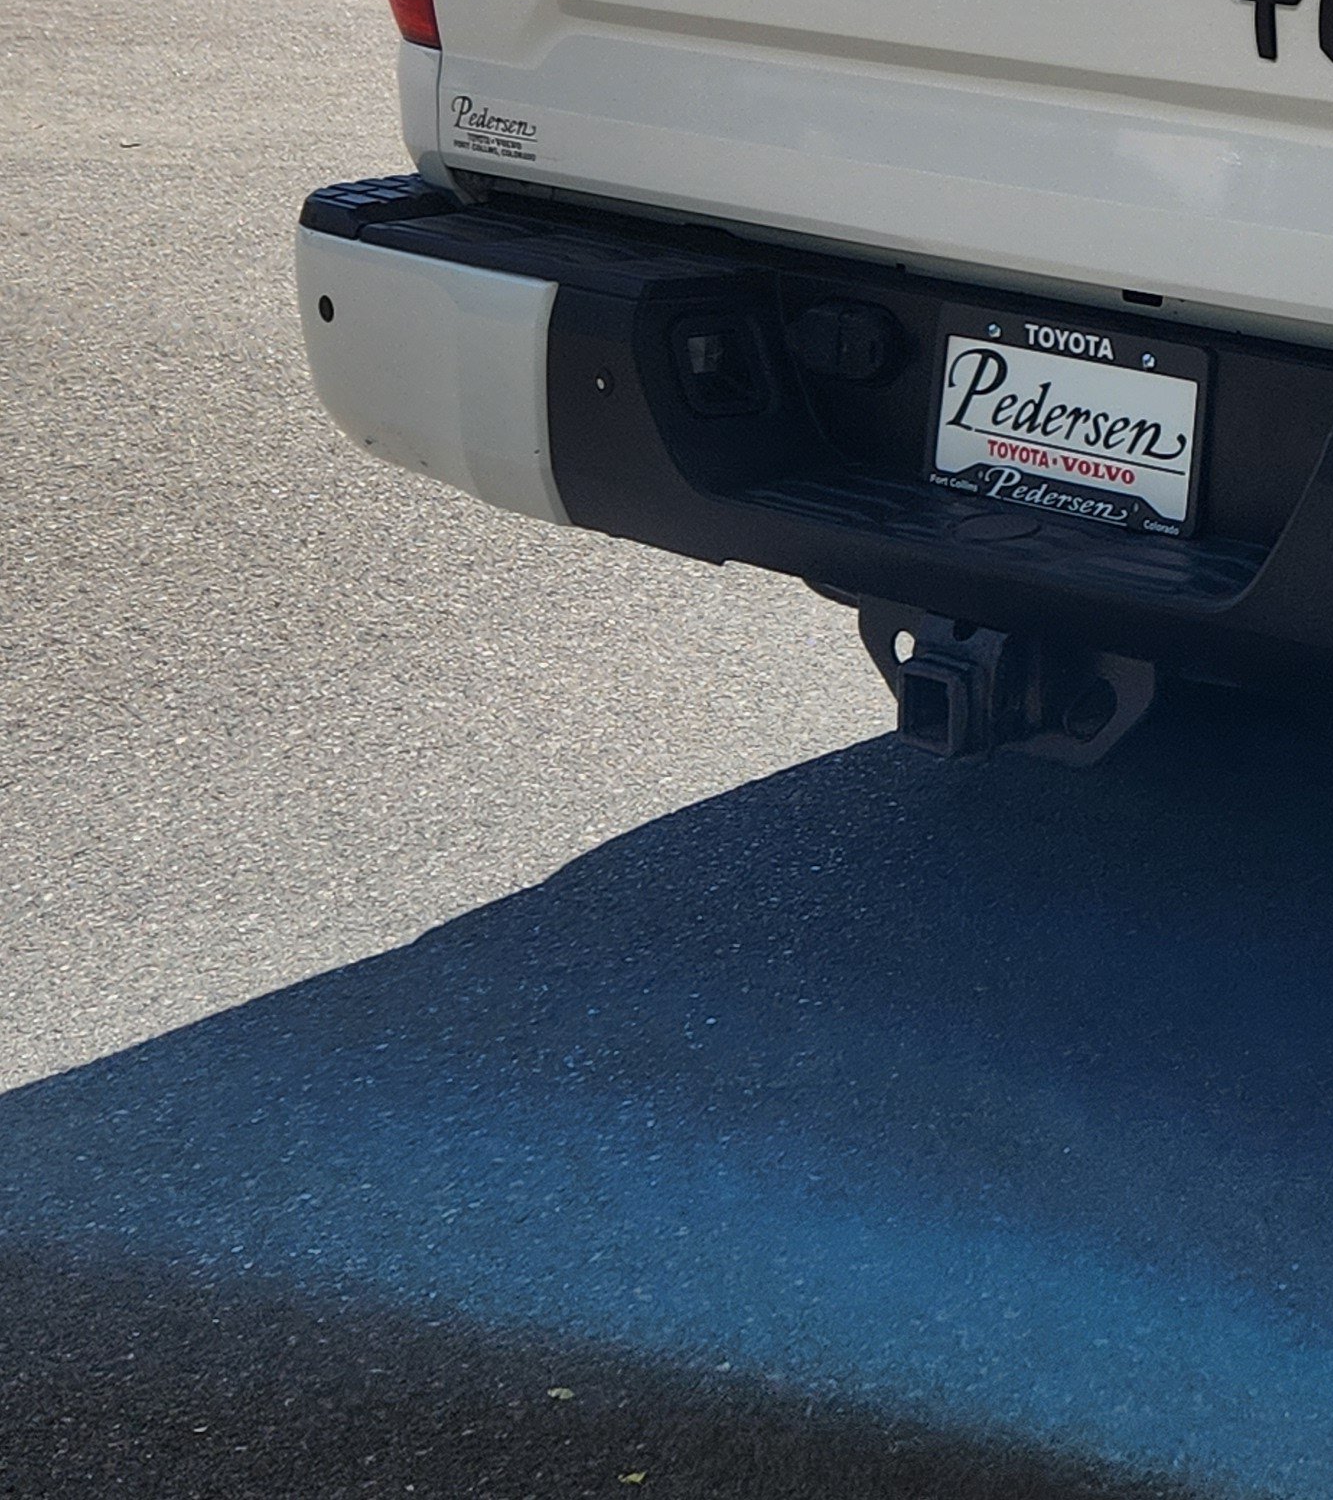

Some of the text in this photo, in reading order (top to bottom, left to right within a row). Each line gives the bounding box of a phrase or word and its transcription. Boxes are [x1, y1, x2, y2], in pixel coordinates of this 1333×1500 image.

[451, 95, 537, 137] Pedersen
[1024, 323, 1115, 360] TOYOTA
[946, 348, 1188, 460] Pedersen
[987, 439, 1136, 485] TOYOTA VOLVO
[984, 466, 1128, 521] Pedersen
[1142, 519, 1181, 537] Colorado
